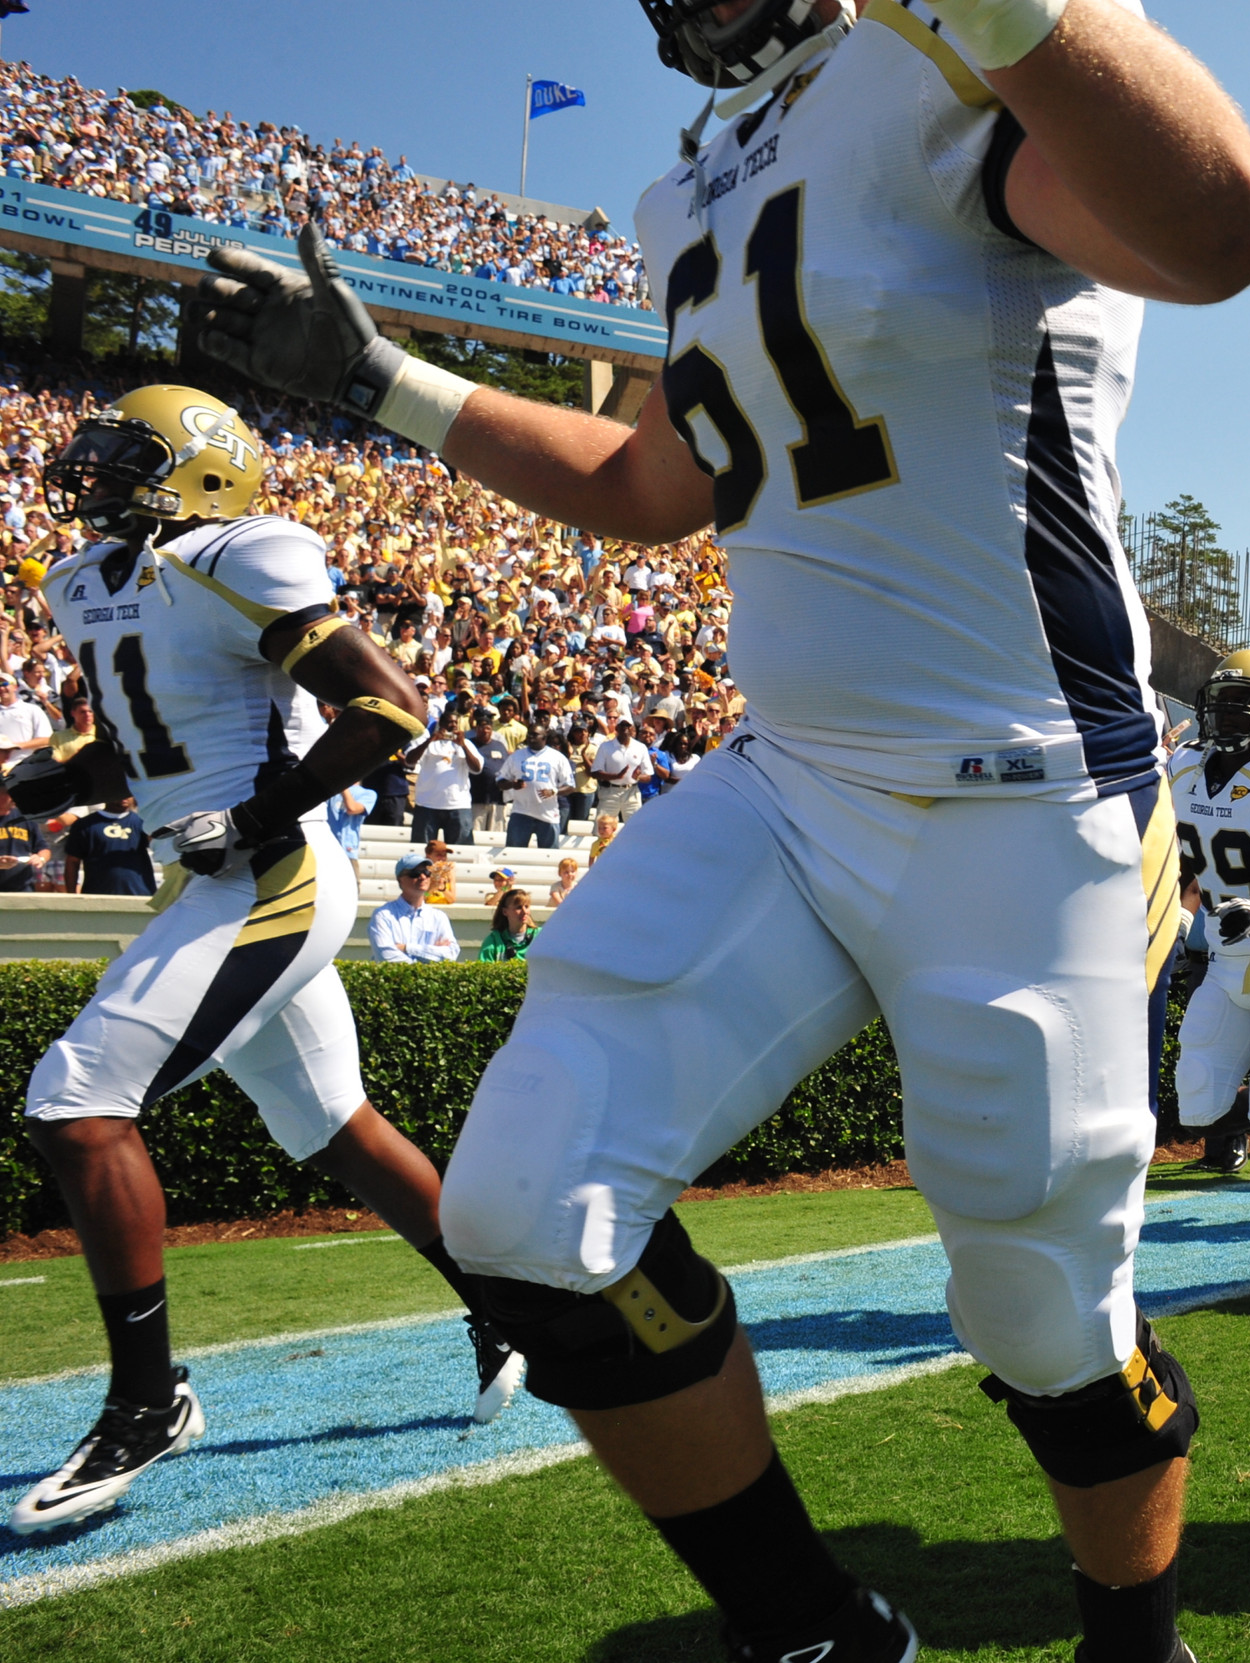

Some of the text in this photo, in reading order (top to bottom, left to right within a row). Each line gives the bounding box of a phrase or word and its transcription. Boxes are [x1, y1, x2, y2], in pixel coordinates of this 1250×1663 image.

[535, 83, 577, 107] DUKE
[687, 133, 779, 219] ORGIA TECH
[2, 204, 82, 231] BOWL
[134, 209, 173, 239] 49
[134, 232, 212, 260] PEPP
[172, 230, 245, 250] JULIUS
[446, 283, 501, 303] 2004
[343, 276, 611, 337] ONTINENTAL TIRE BOWL
[662, 180, 900, 540] 61
[83, 603, 140, 625] GEORGIA TECH
[78, 632, 196, 781] 11
[521, 760, 551, 783] 52
[1006, 758, 1034, 771] XL
[1190, 803, 1233, 818] GEORGIA TECH
